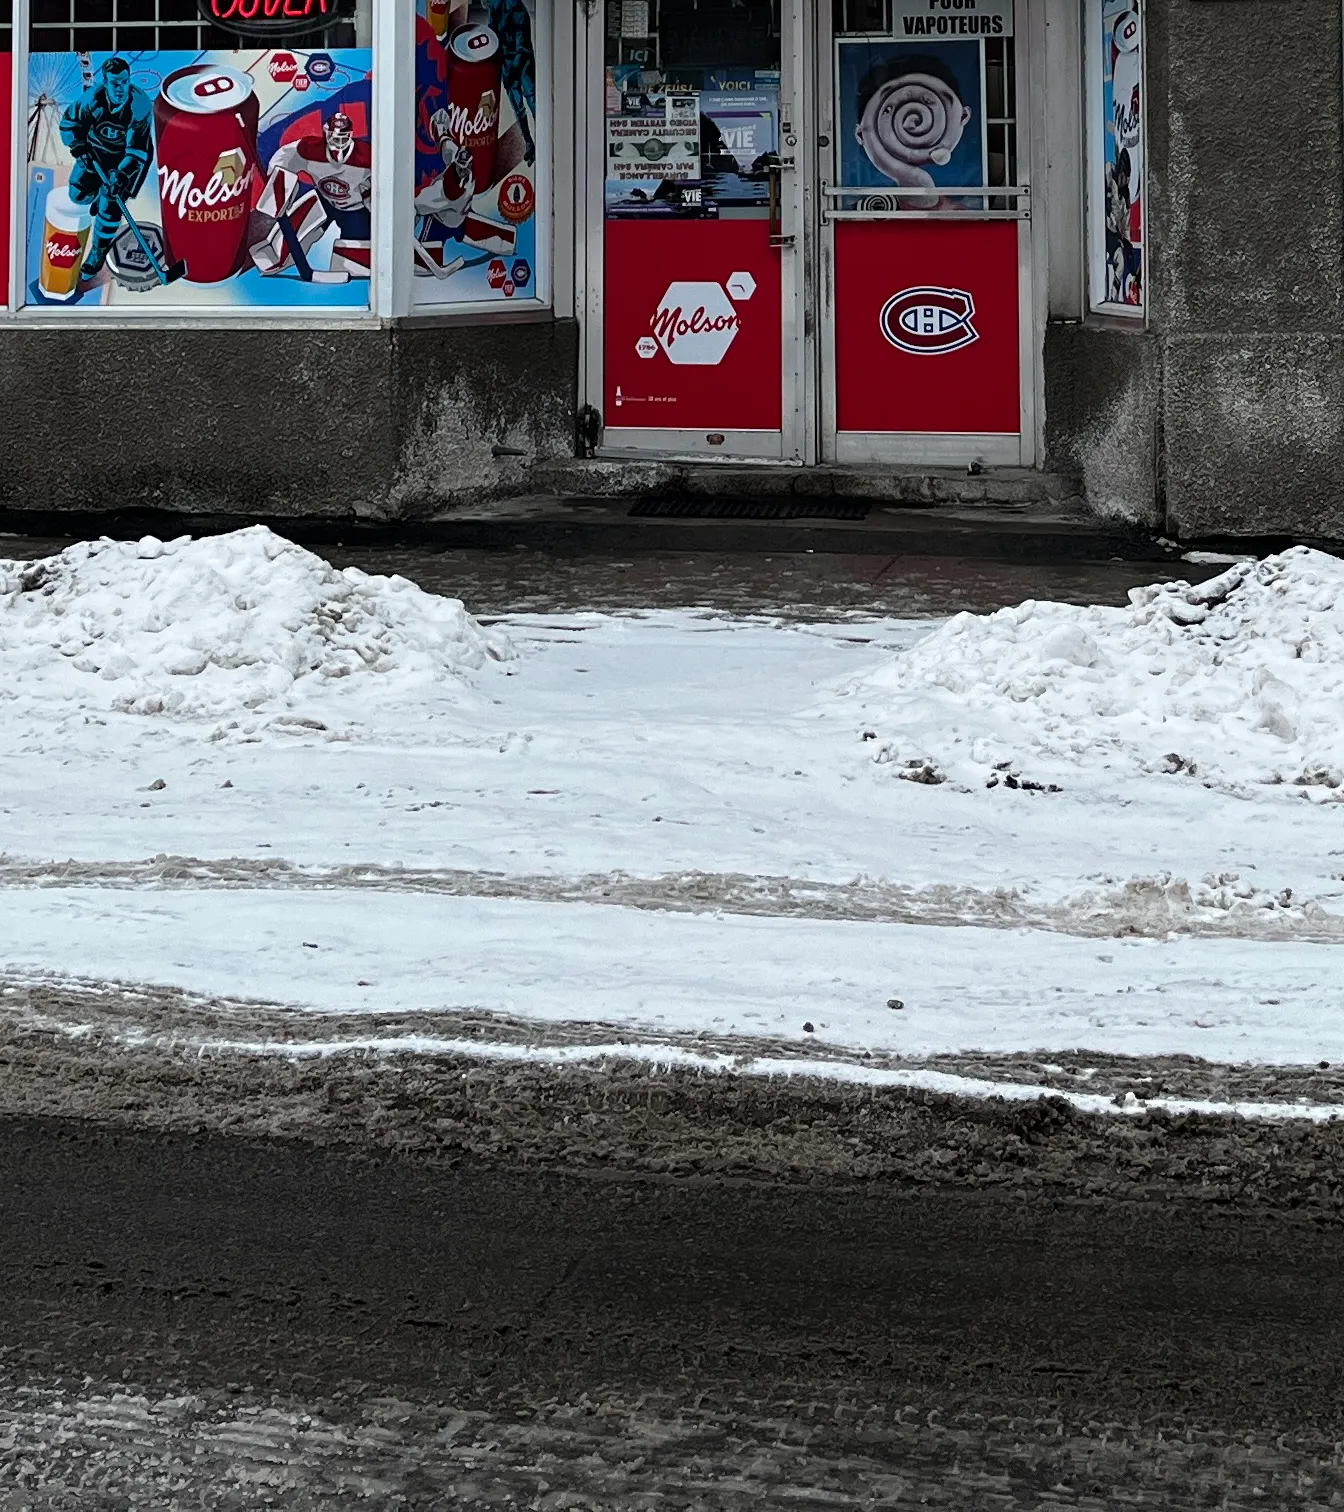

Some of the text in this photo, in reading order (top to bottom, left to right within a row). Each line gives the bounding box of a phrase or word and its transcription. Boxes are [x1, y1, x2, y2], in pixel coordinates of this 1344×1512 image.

[903, 15, 1003, 35] VAPOTEURS
[725, 130, 754, 149] VIE
[157, 162, 257, 220] Molson
[188, 206, 234, 223] EXPORT
[649, 307, 741, 347] Molson
